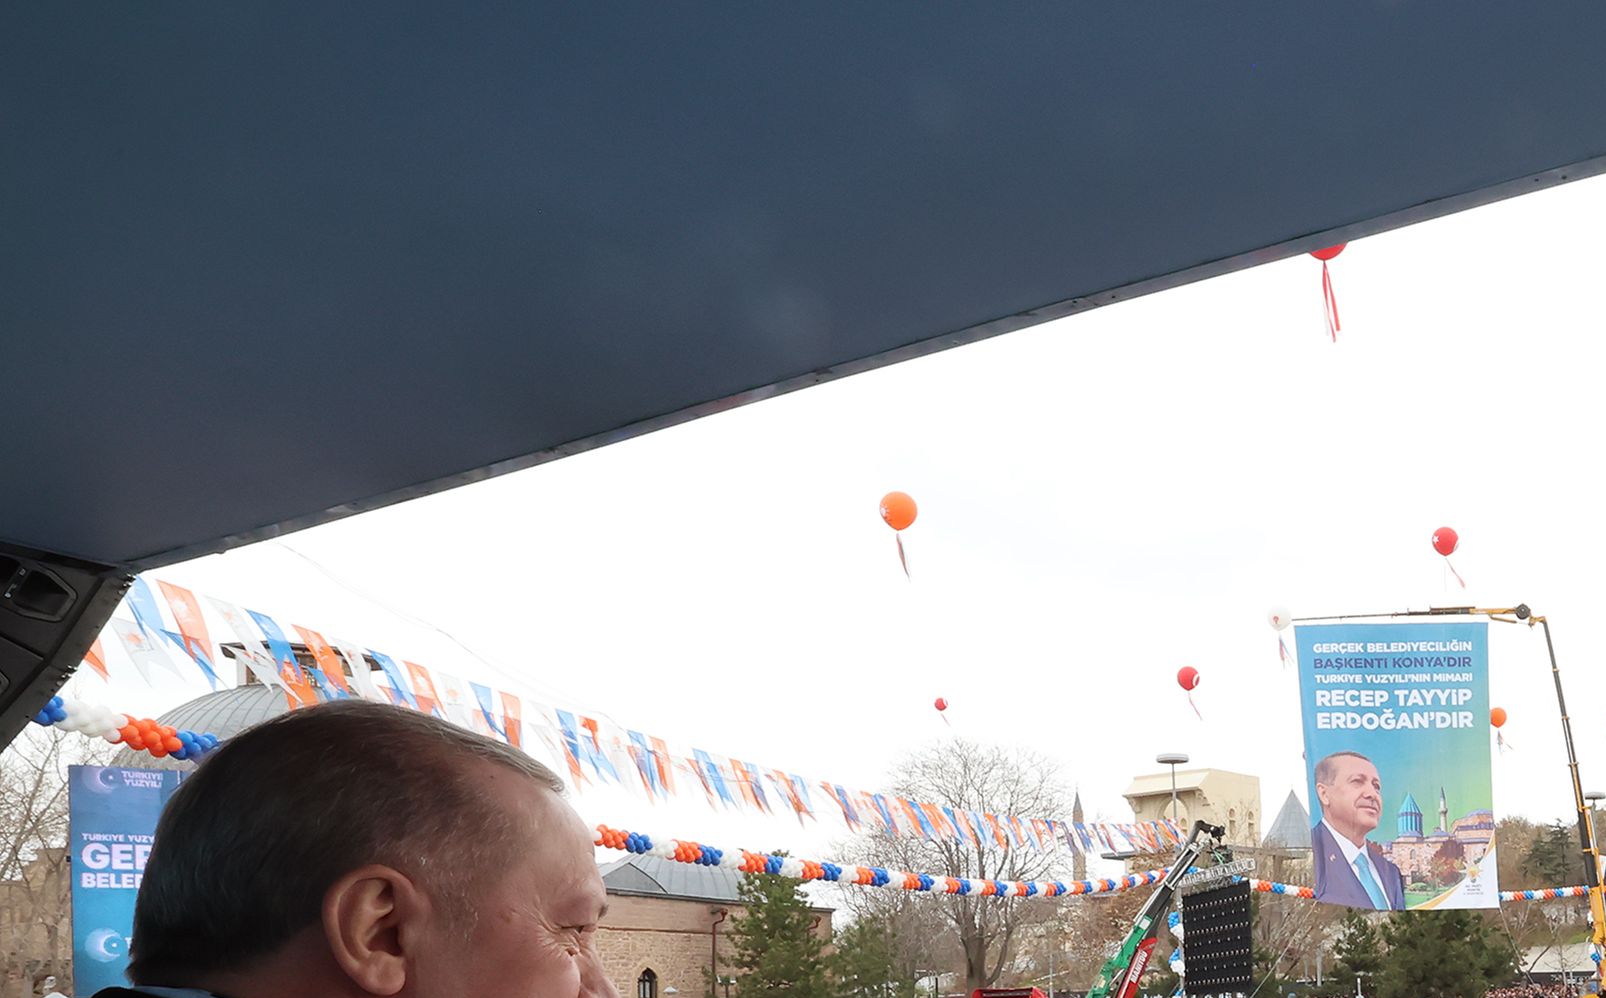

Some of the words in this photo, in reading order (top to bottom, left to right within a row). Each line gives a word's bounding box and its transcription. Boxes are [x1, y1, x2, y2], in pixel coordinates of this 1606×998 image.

[1313, 643, 1364, 654] GERÇEK
[1315, 690, 1389, 707] RECEP
[1394, 689, 1472, 707] TAYYİP
[1316, 708, 1474, 730] ERDOĞAN'DIR
